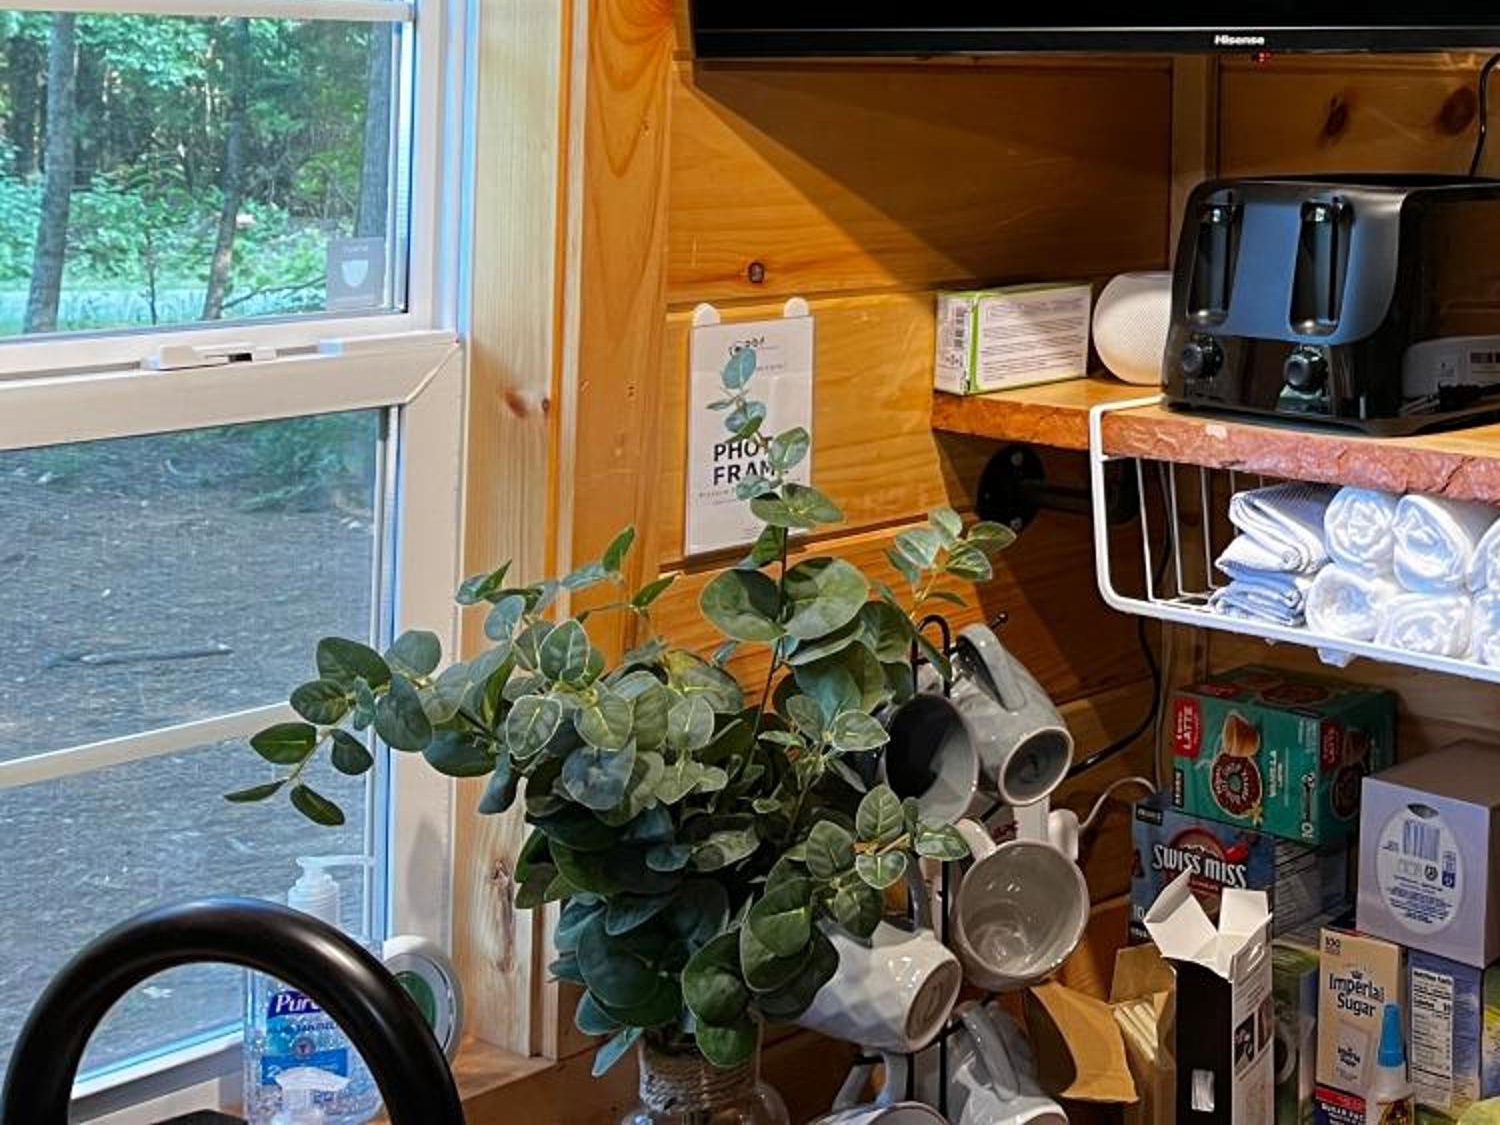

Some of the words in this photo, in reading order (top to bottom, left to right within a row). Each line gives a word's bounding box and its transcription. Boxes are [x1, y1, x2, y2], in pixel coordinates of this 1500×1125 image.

[1213, 34, 1265, 46] Hisense
[713, 435, 774, 462] PHOT
[713, 460, 789, 486] FRAM
[1183, 706, 1194, 751] LATTE
[1152, 843, 1202, 875] SWISS
[1204, 858, 1248, 889] MISS
[1329, 972, 1386, 1004] Imperial
[1337, 992, 1376, 1017] Sugar
